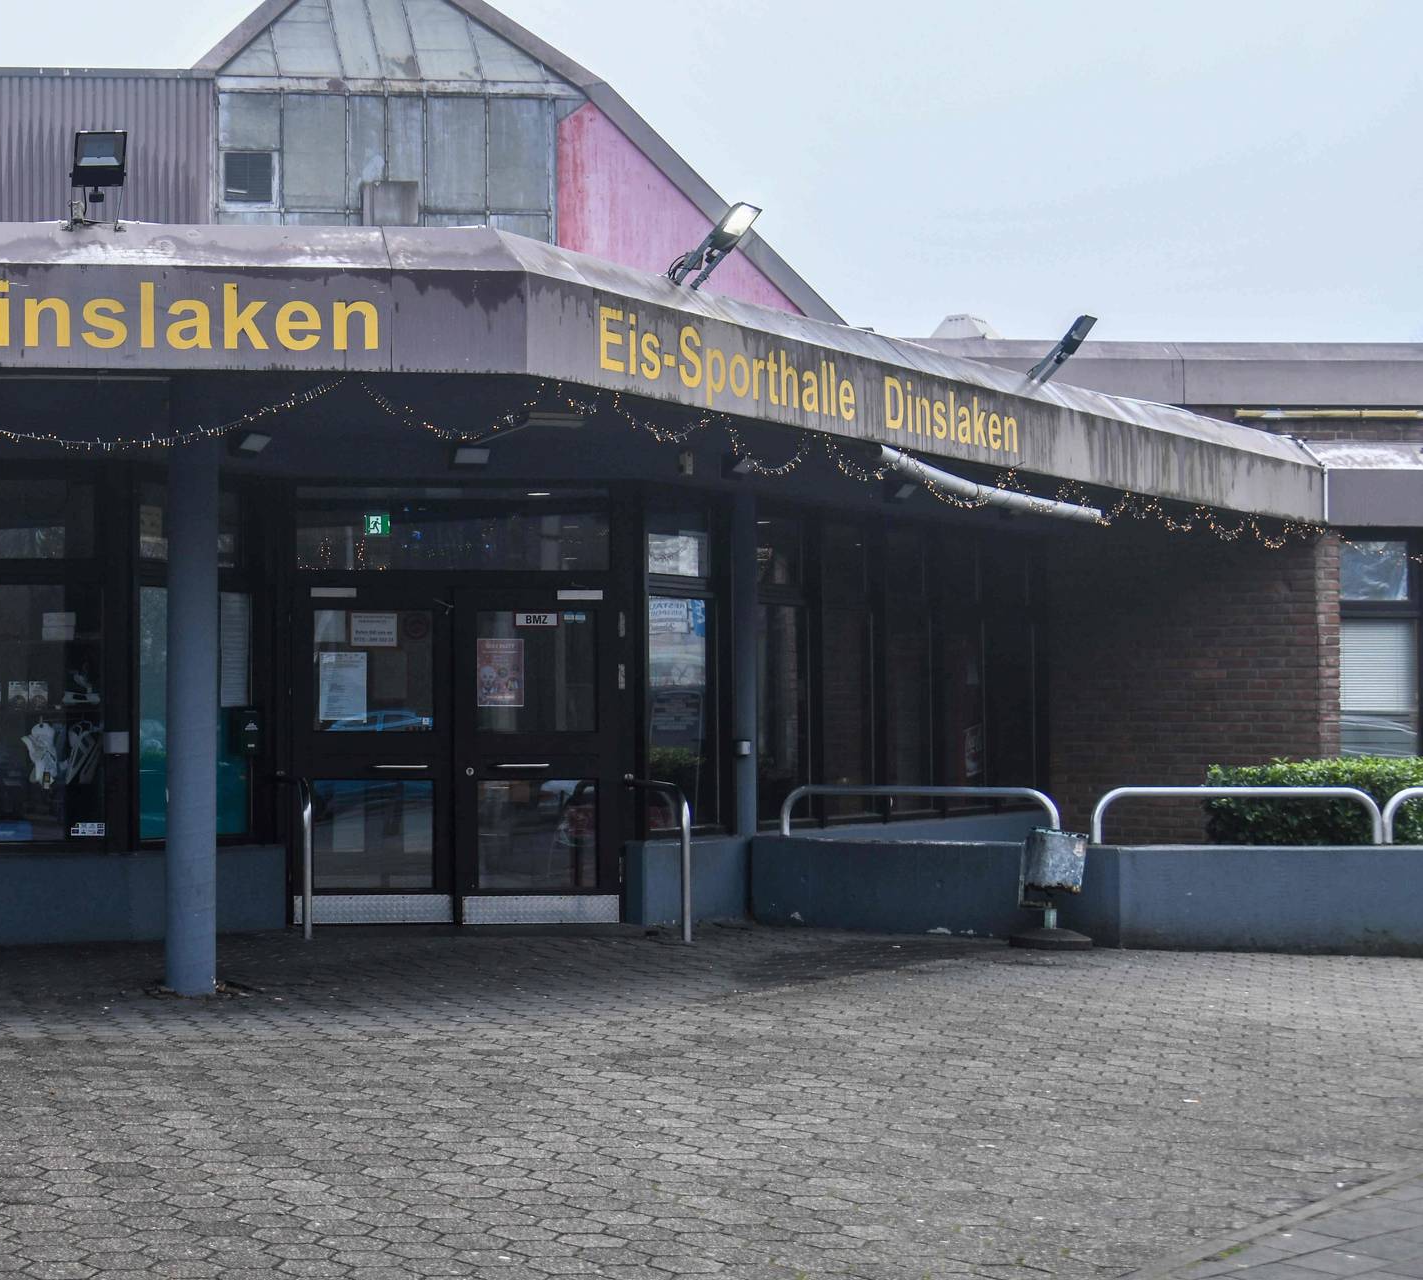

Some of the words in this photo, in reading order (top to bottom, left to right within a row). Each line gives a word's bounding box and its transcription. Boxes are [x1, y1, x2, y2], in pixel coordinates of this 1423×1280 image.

[599, 306, 856, 422] Eis-Sporthalle
[884, 375, 1019, 454] Dinslaken
[525, 614, 548, 625] BMZ
